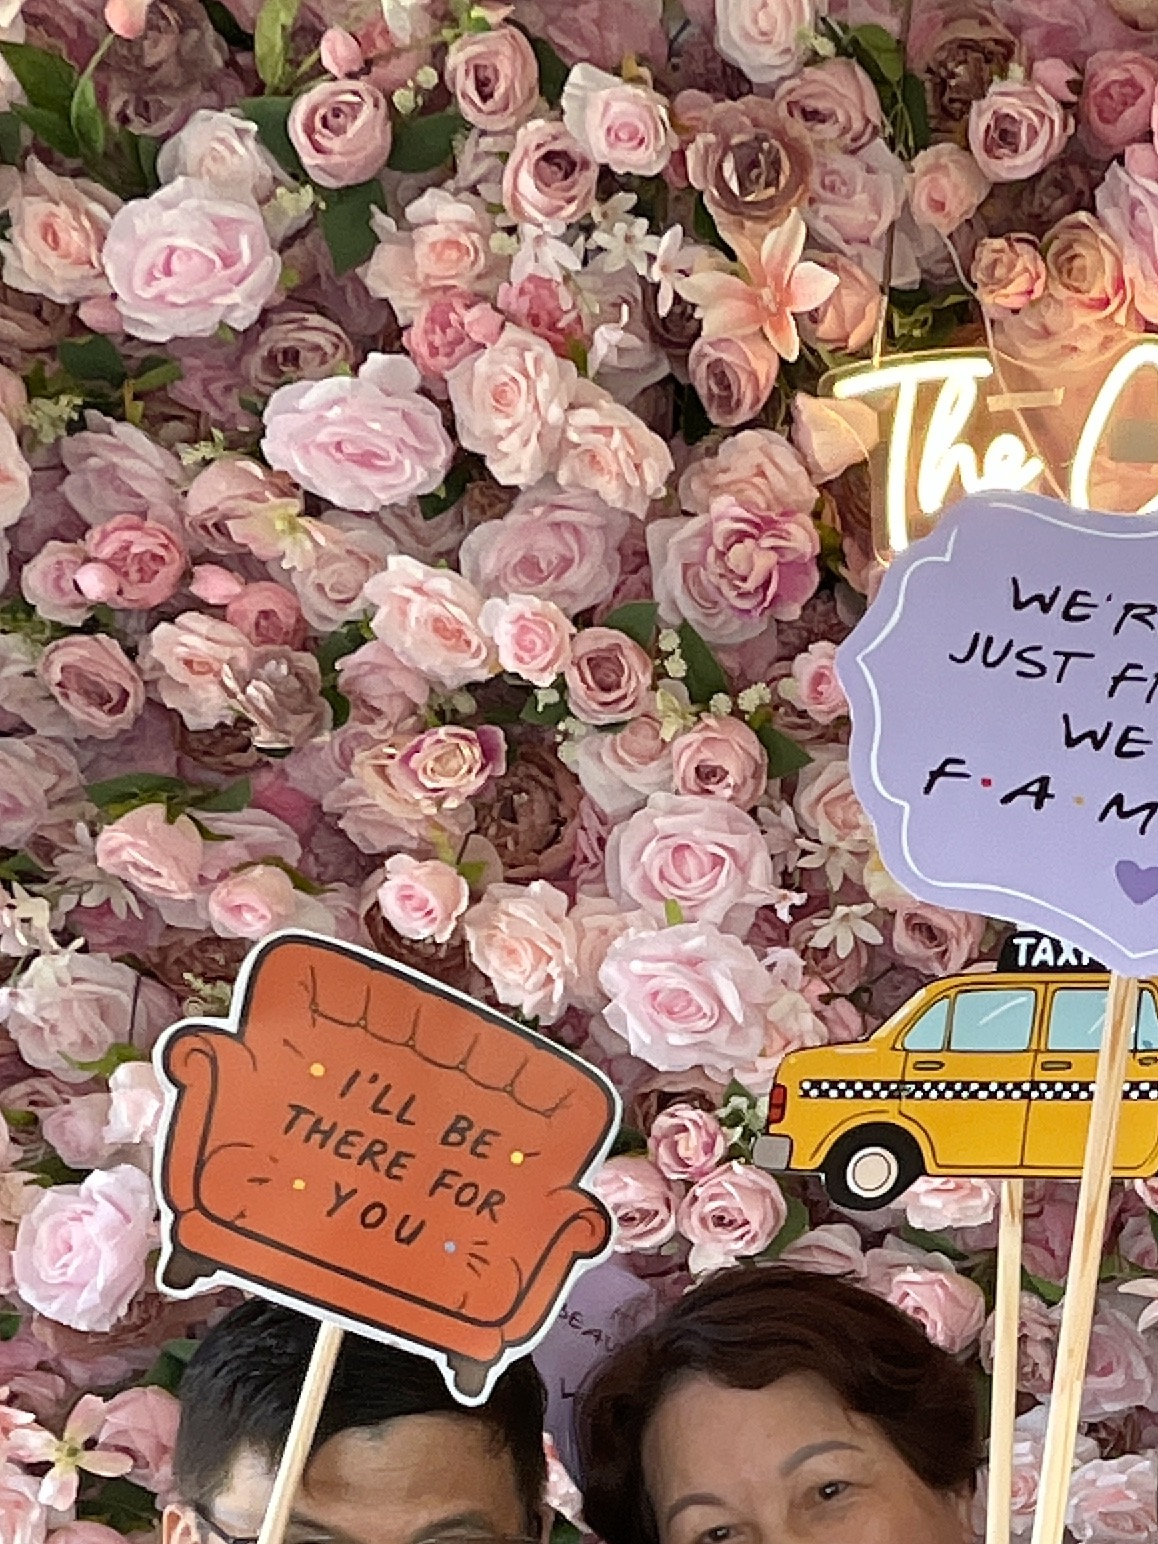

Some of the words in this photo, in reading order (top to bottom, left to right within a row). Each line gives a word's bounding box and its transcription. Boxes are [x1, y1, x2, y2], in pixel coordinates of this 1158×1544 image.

[834, 356, 1043, 552] The
[949, 631, 1095, 684] JUST
[339, 1068, 416, 1127] I'LL
[441, 1115, 501, 1160] BE
[283, 1103, 416, 1181] THERE
[428, 1168, 506, 1224] FOR
[326, 1181, 427, 1247] YOU
